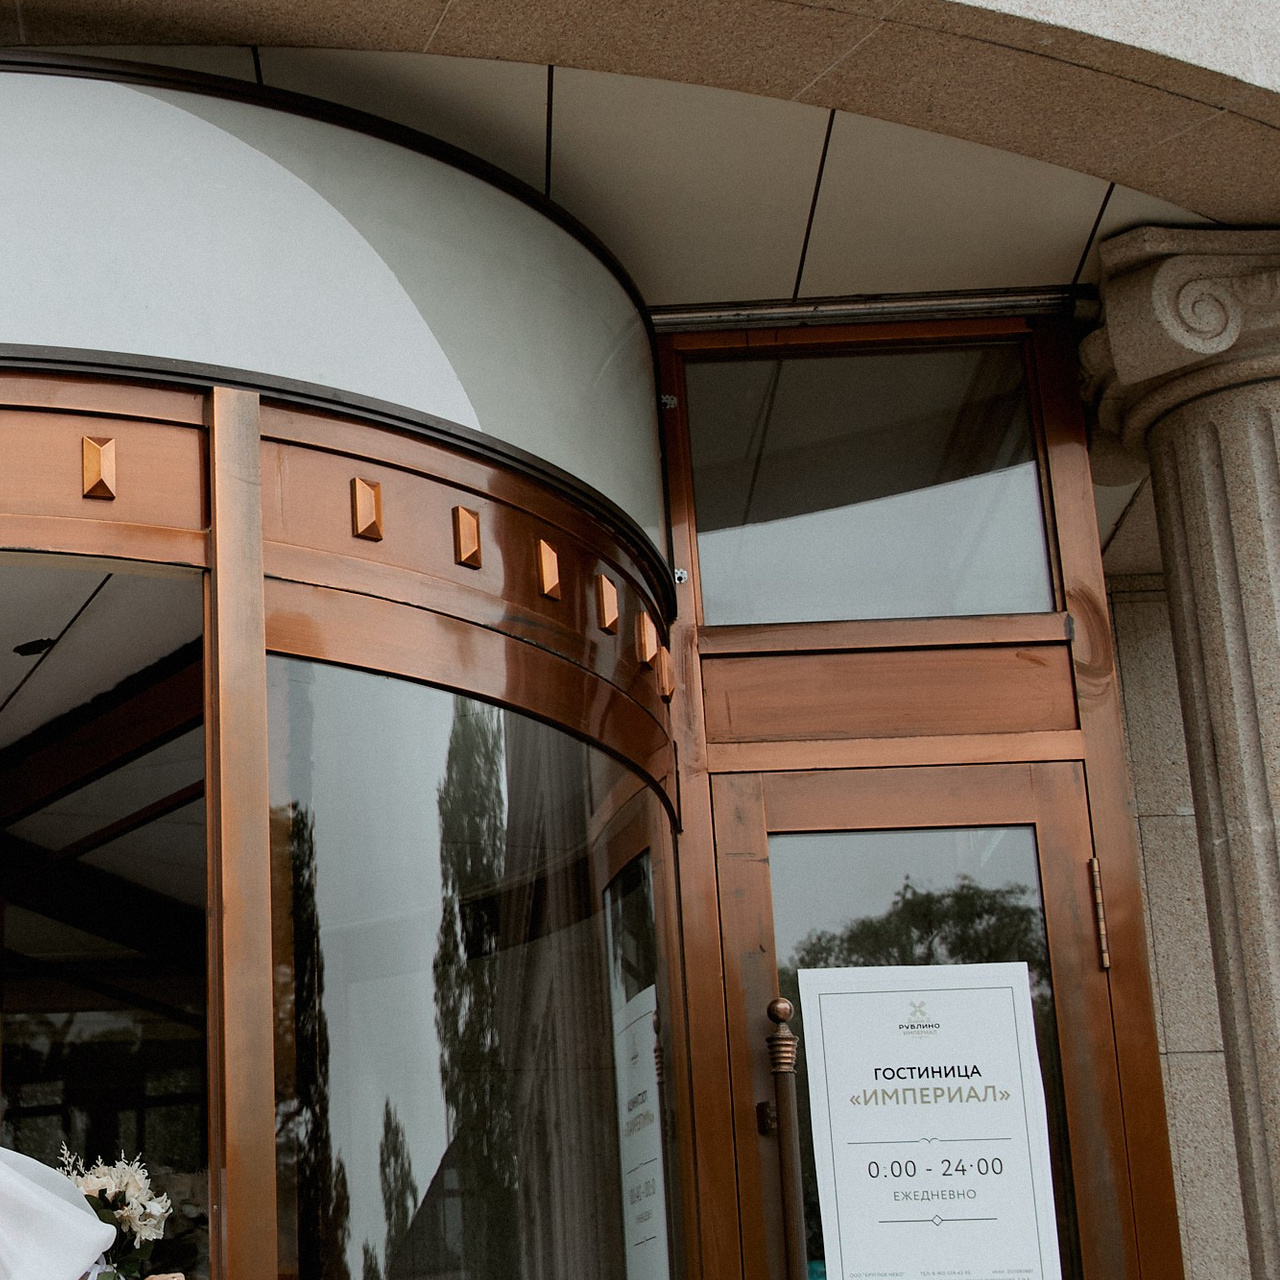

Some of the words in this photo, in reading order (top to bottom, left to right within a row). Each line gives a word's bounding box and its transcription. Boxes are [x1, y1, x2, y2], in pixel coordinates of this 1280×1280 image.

[873, 1064, 982, 1081] ГОСТИНИЦА
[849, 1085, 1011, 1107] «ИМПЕРИАЛ»
[867, 1160, 917, 1179] 0:00
[893, 1188, 977, 1202] ЕЖЕДНЕВНО
